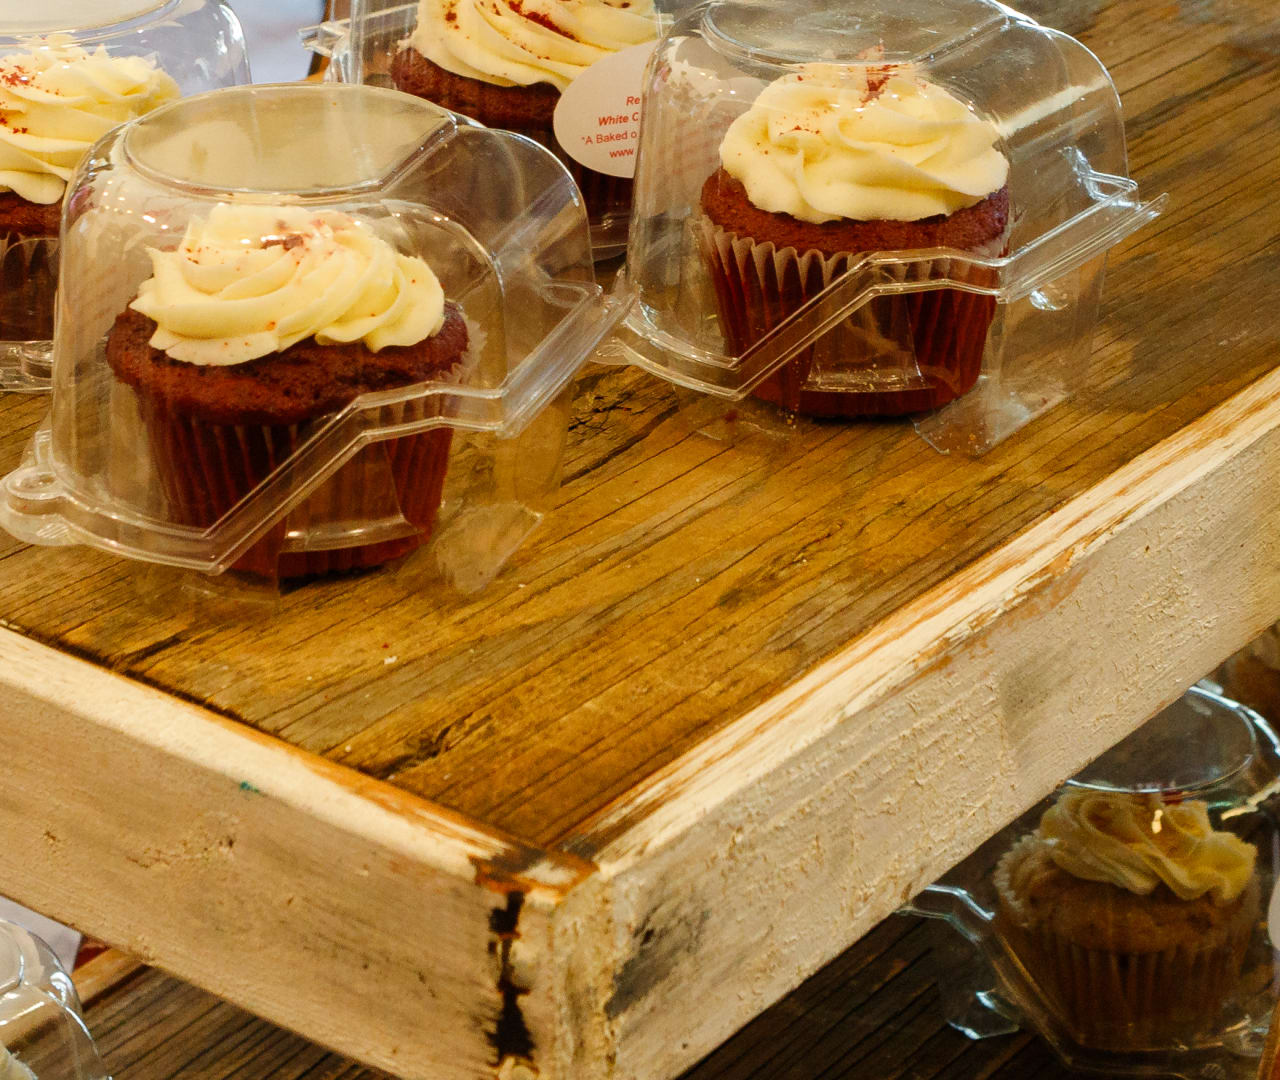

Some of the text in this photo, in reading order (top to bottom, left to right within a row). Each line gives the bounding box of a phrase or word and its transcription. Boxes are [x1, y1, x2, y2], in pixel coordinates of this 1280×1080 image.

[598, 115, 628, 126] White
[596, 131, 628, 144] Baked
[609, 148, 634, 158] www
